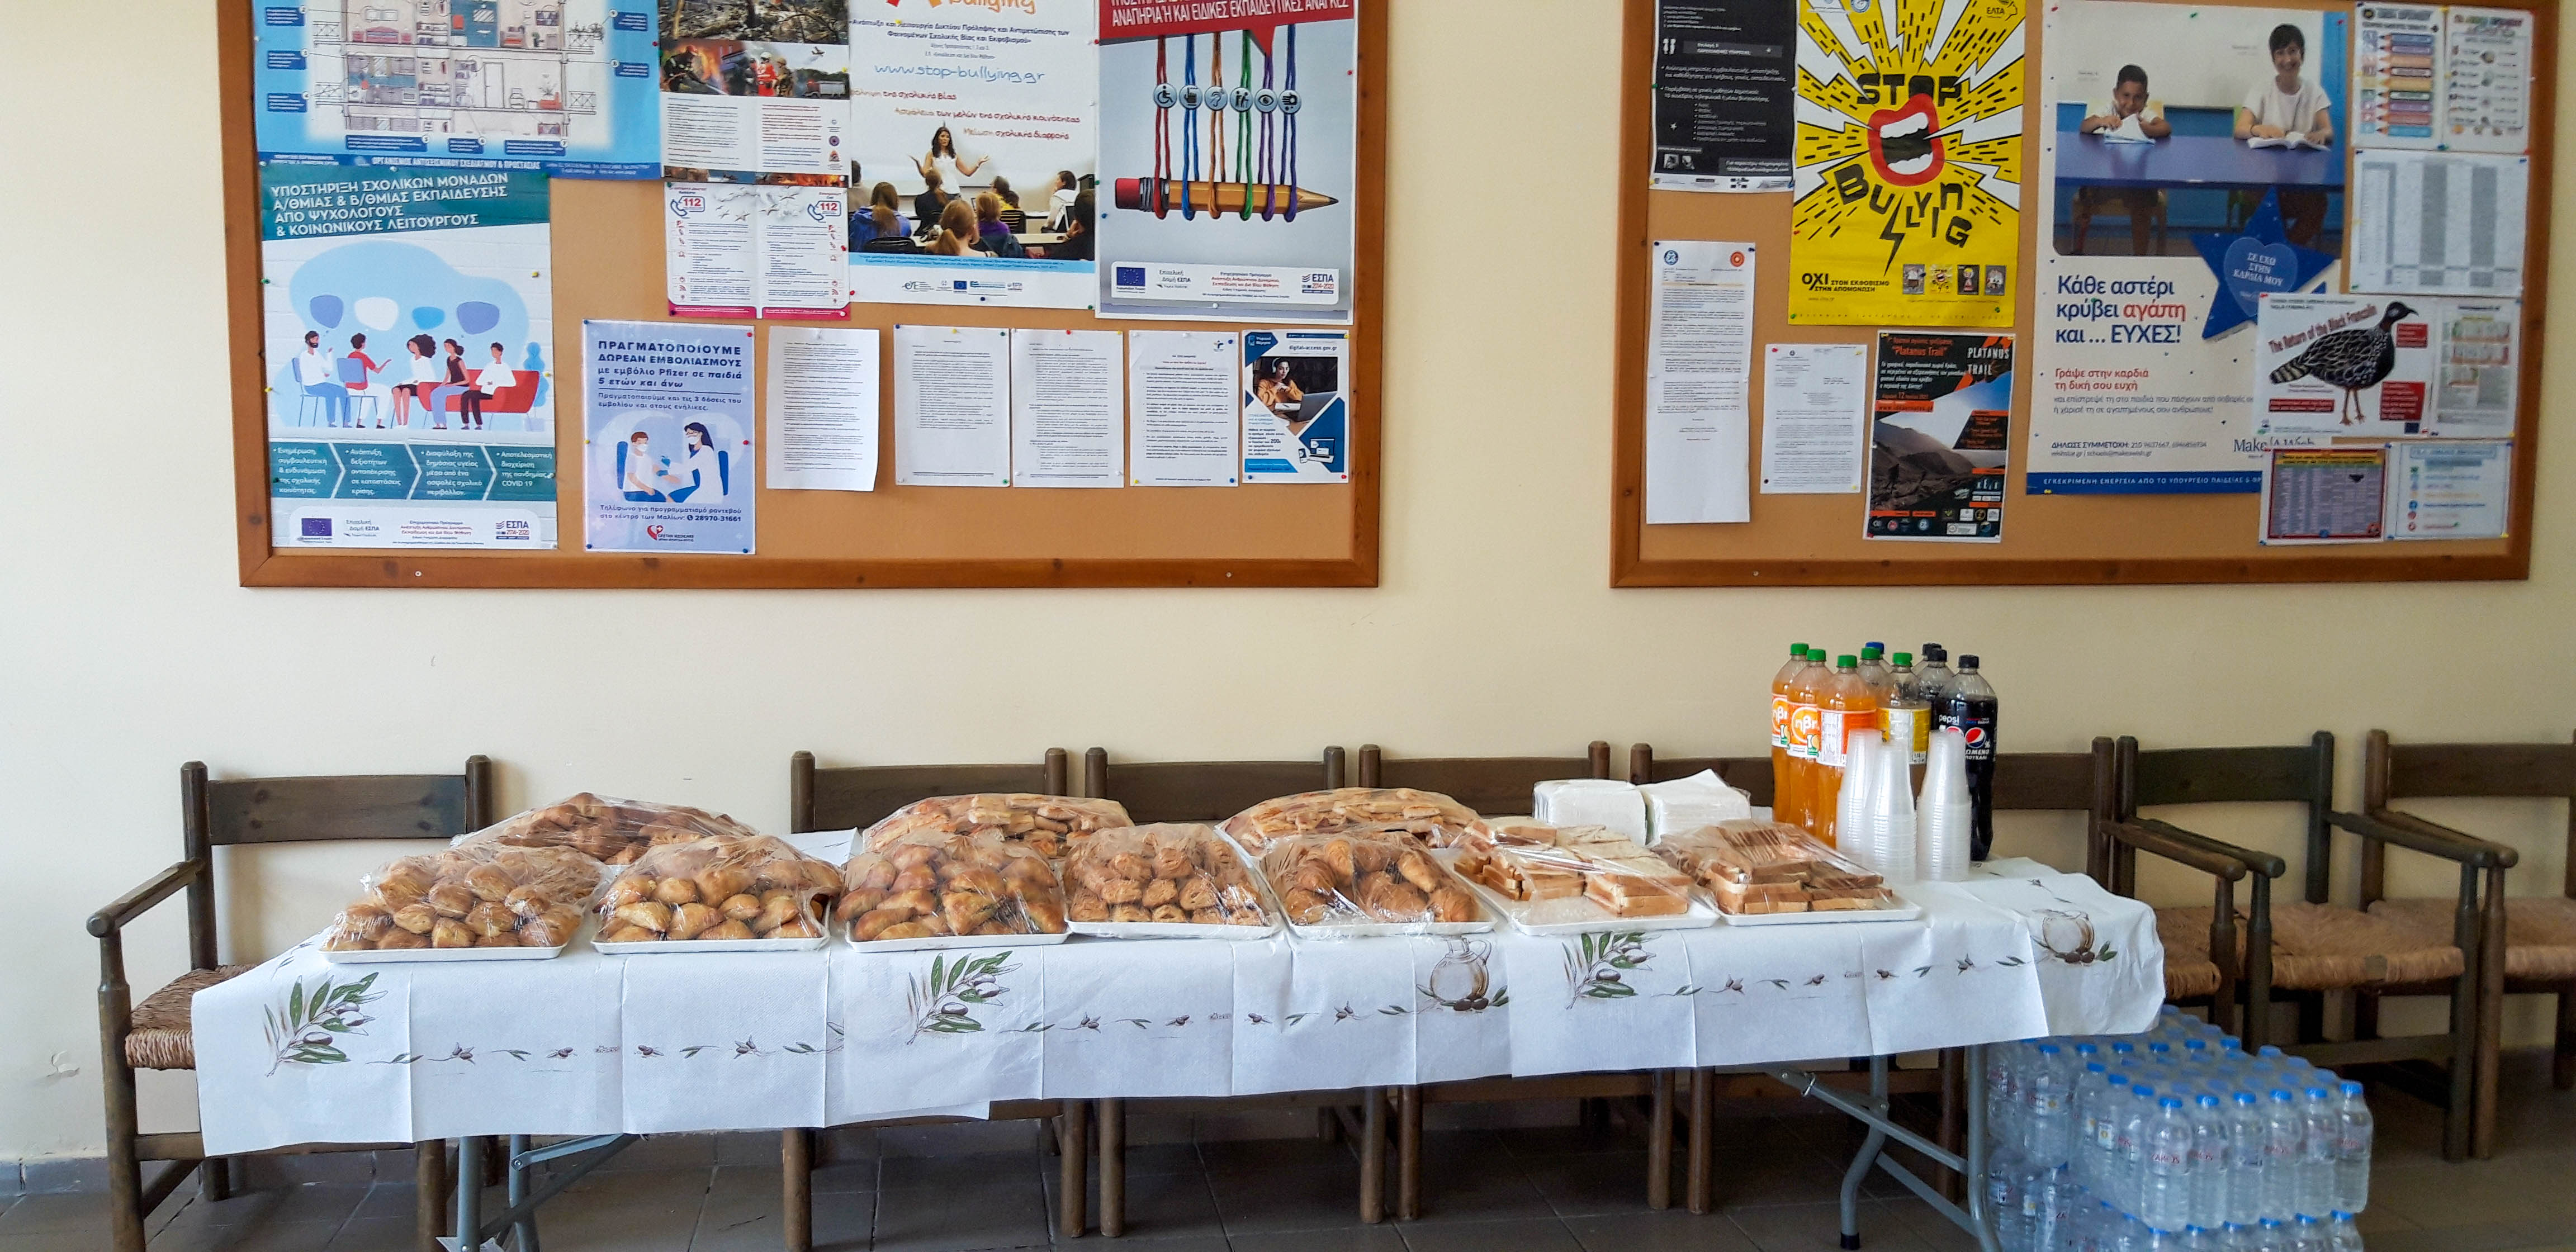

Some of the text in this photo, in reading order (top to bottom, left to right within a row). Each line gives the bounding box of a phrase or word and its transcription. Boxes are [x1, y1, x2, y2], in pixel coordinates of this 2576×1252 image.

[1174, 4, 1190, 22] ΚΑΙ
[1192, 1, 1229, 20] ΕΙΔΙΚΕΣ
[874, 65, 1045, 83] www.stop-bullying.gr
[1857, 73, 1962, 107] STOP
[272, 172, 508, 197] ΥΠΟΣΤΗΡΙΞΗ ΣΧΟΛΙΚΩΝ ΜΟΝΑΔΩΝ
[273, 186, 508, 211] Α/ΘΜΙΑΣ & Β/ΘΜΙΑΣ ΕΚΠΑΙΔΕΥΣΗΣ
[275, 205, 404, 223] ΑΠΟ ΨΥΧΟΛΟΓΟΥΣ
[277, 214, 479, 236] & ΚΟΙΝΩΝΙΚΟΥΣ ΛΕΙΤΟΥΡΓΟΥΣ
[1312, 274, 1334, 282] ΕΣΠΑ
[1802, 273, 1829, 291] ΟΧΙ
[2057, 274, 2175, 298] Κάθε αστέρι
[2057, 300, 2186, 323] κρύβει αγάπη
[2111, 325, 2181, 343] ΕΥΧΕΣ!
[599, 340, 741, 355] ΠΡΑΓΜΑΤΟΠΟΙΟΥΜΕ
[1967, 347, 2009, 359] PLATANUS
[598, 354, 741, 367] ΔΩΡΕΑΝ ΕΜΒΟΛΙΑΣΜΟΥΣ
[1967, 363, 1992, 375] TRAIL
[614, 367, 654, 376] εμβόλιο
[660, 368, 688, 377] Pfizer
[2055, 368, 2148, 379] Γράψε στην καρδιά
[2054, 382, 2066, 391] τη
[2069, 380, 2090, 391] δική
[2115, 381, 2138, 391] ευχή
[506, 520, 529, 529] ΕΣΠΑ
[1939, 714, 1959, 725] pepsi
